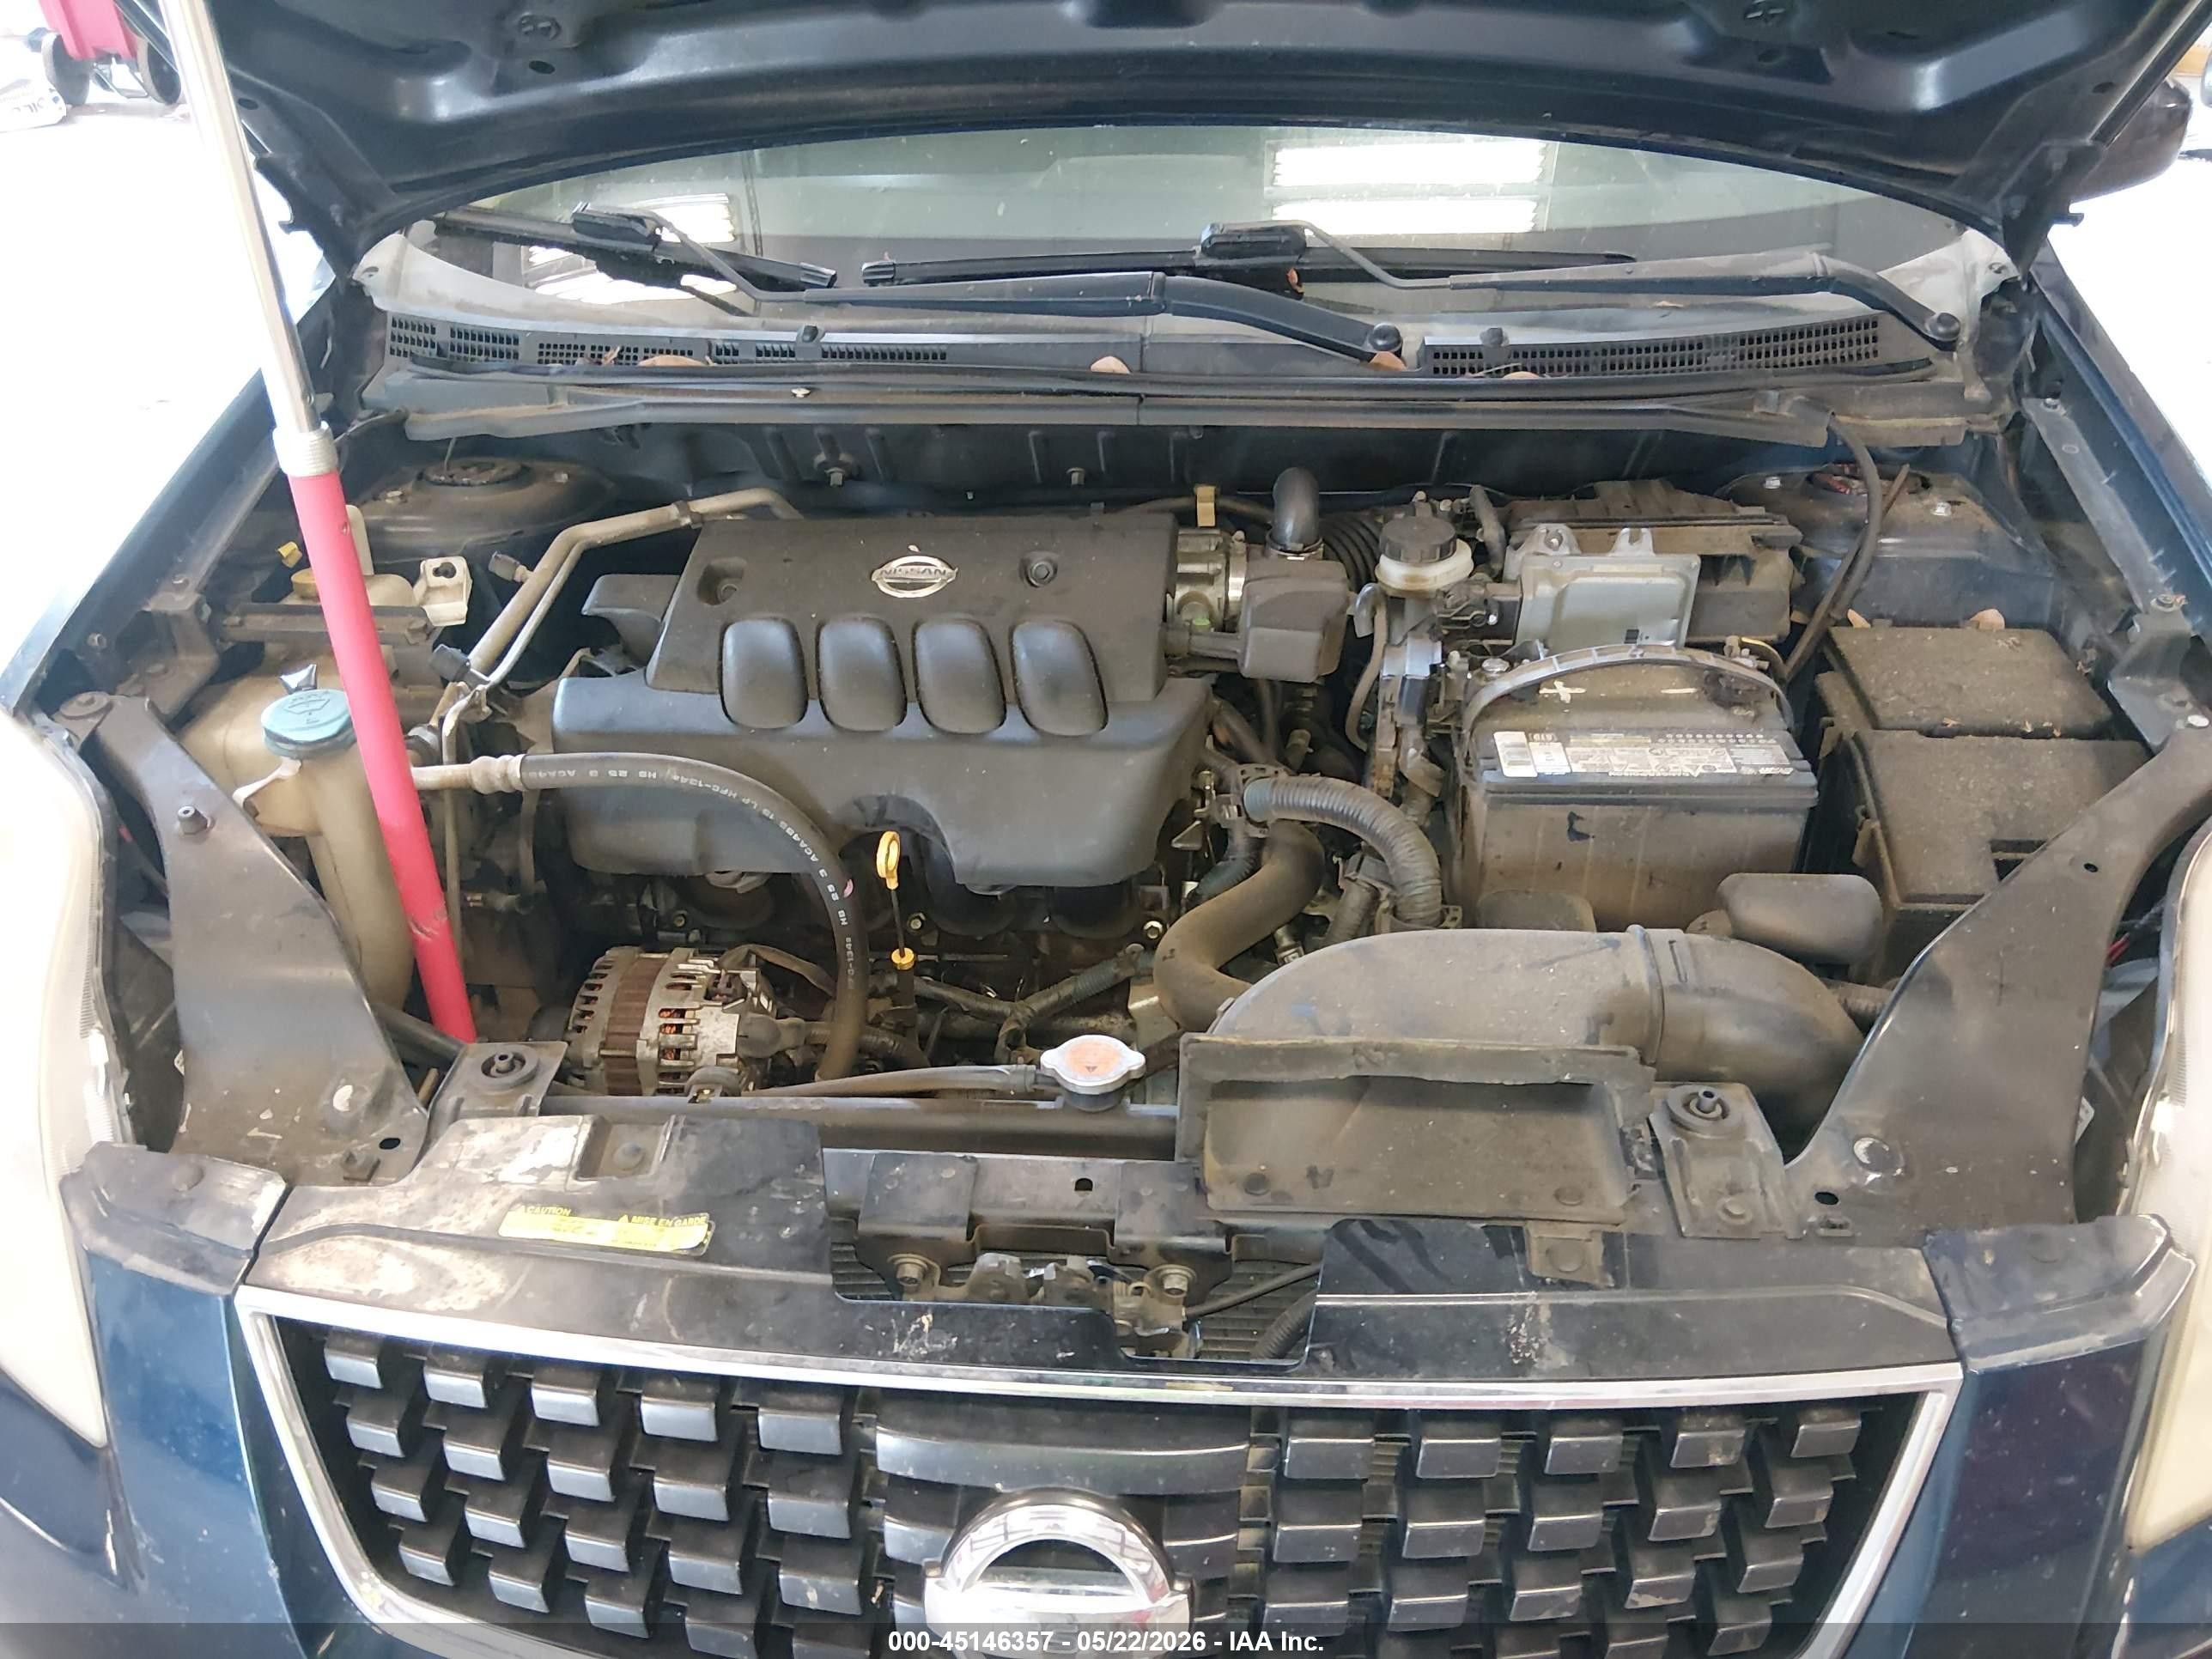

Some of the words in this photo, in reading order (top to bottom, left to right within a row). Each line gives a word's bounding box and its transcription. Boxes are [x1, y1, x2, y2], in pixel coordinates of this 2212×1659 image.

[527, 1206, 572, 1217] CAUTION
[631, 1215, 655, 1225] MISE
[658, 1217, 674, 1227] EN
[675, 1216, 708, 1227] GARDE
